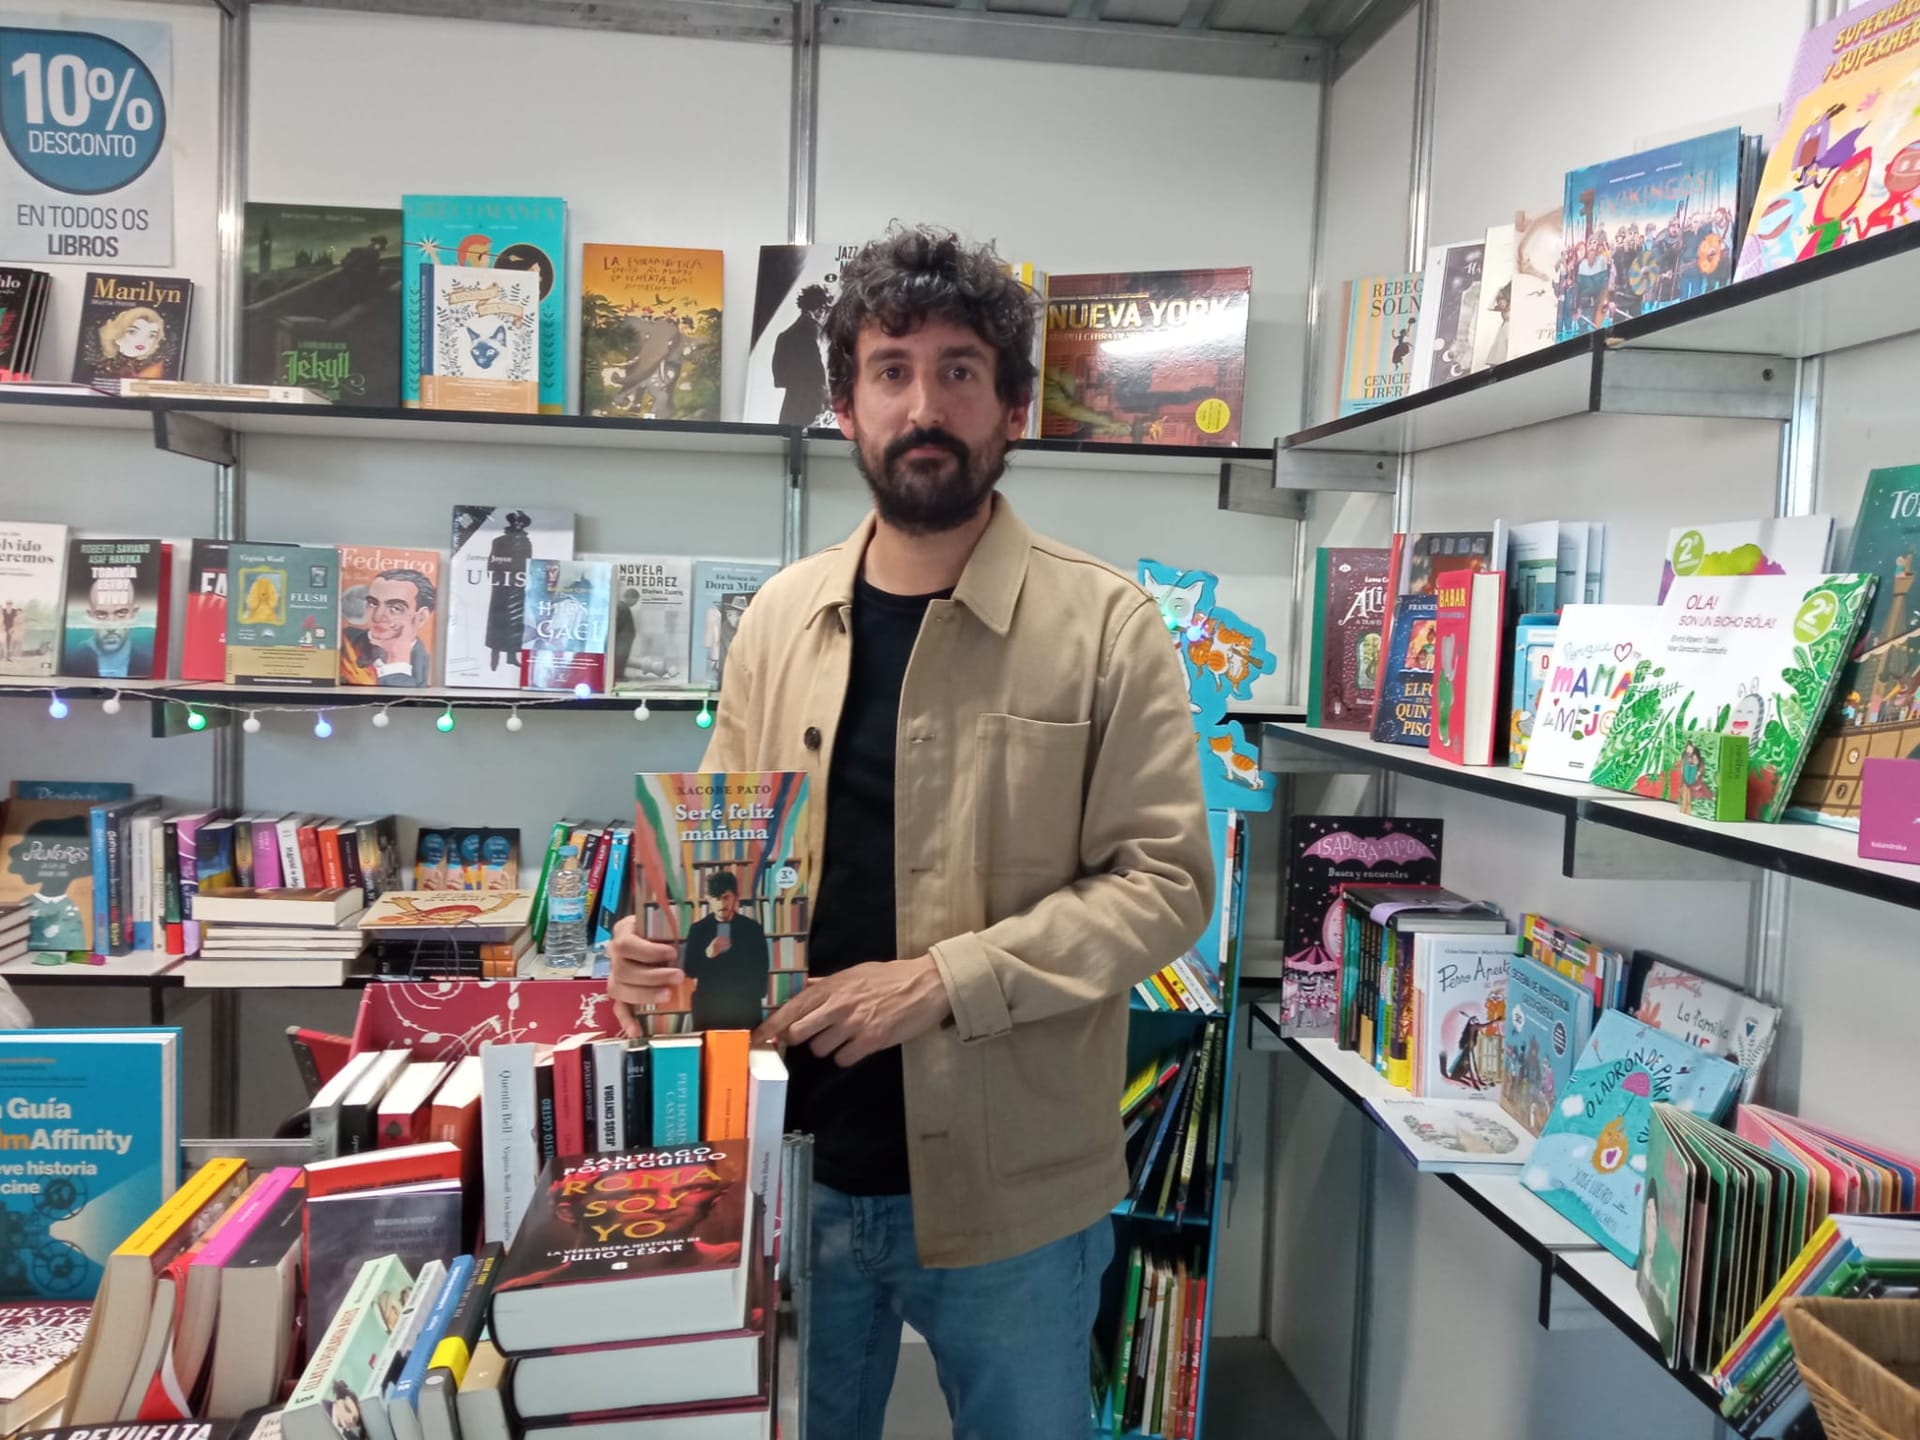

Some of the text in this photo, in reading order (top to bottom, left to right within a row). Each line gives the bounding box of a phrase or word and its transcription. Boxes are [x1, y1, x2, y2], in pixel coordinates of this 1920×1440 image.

[11, 53, 154, 131] 10%
[28, 130, 136, 158] DESCONTO
[17, 204, 149, 231] EN TODOS OS
[48, 234, 119, 258] LIBROS
[94, 278, 182, 308] Marilyn
[1372, 279, 1423, 298] REBEC
[1050, 303, 1143, 329] NUEVA
[1371, 297, 1423, 318] SOLN
[281, 350, 350, 388] Jekyll
[1364, 386, 1408, 399] LIBER
[1891, 490, 1920, 519] TO
[0, 538, 42, 552] lvido
[0, 553, 54, 565] eremos
[341, 547, 434, 575] Federico
[467, 570, 526, 587] ULIS
[619, 564, 663, 576] NOVELA
[627, 577, 678, 588] AJEDREZ
[289, 592, 328, 603] FLUSH
[678, 785, 772, 796] XACOBE PATO
[675, 803, 774, 821] Seré feliz
[681, 826, 769, 841] mañana
[1328, 867, 1354, 878] Busca
[1438, 963, 1471, 992] Perro
[499, 1070, 511, 1110] Quentin
[7, 1098, 71, 1120] Guía
[604, 1085, 615, 1147] JESÚS CINTORA
[502, 1113, 512, 1133] Bell
[0, 1128, 132, 1155] lmAffinity
[563, 1152, 728, 1176] POSTEGUILLO
[584, 1147, 712, 1167] SANTIAGO
[27, 1161, 97, 1175] historia
[562, 1168, 721, 1197] ROMA
[584, 1192, 690, 1217] SOY
[592, 1220, 667, 1242] YO
[561, 1251, 618, 1264] JULIO
[0, 1306, 91, 1317] BECC
